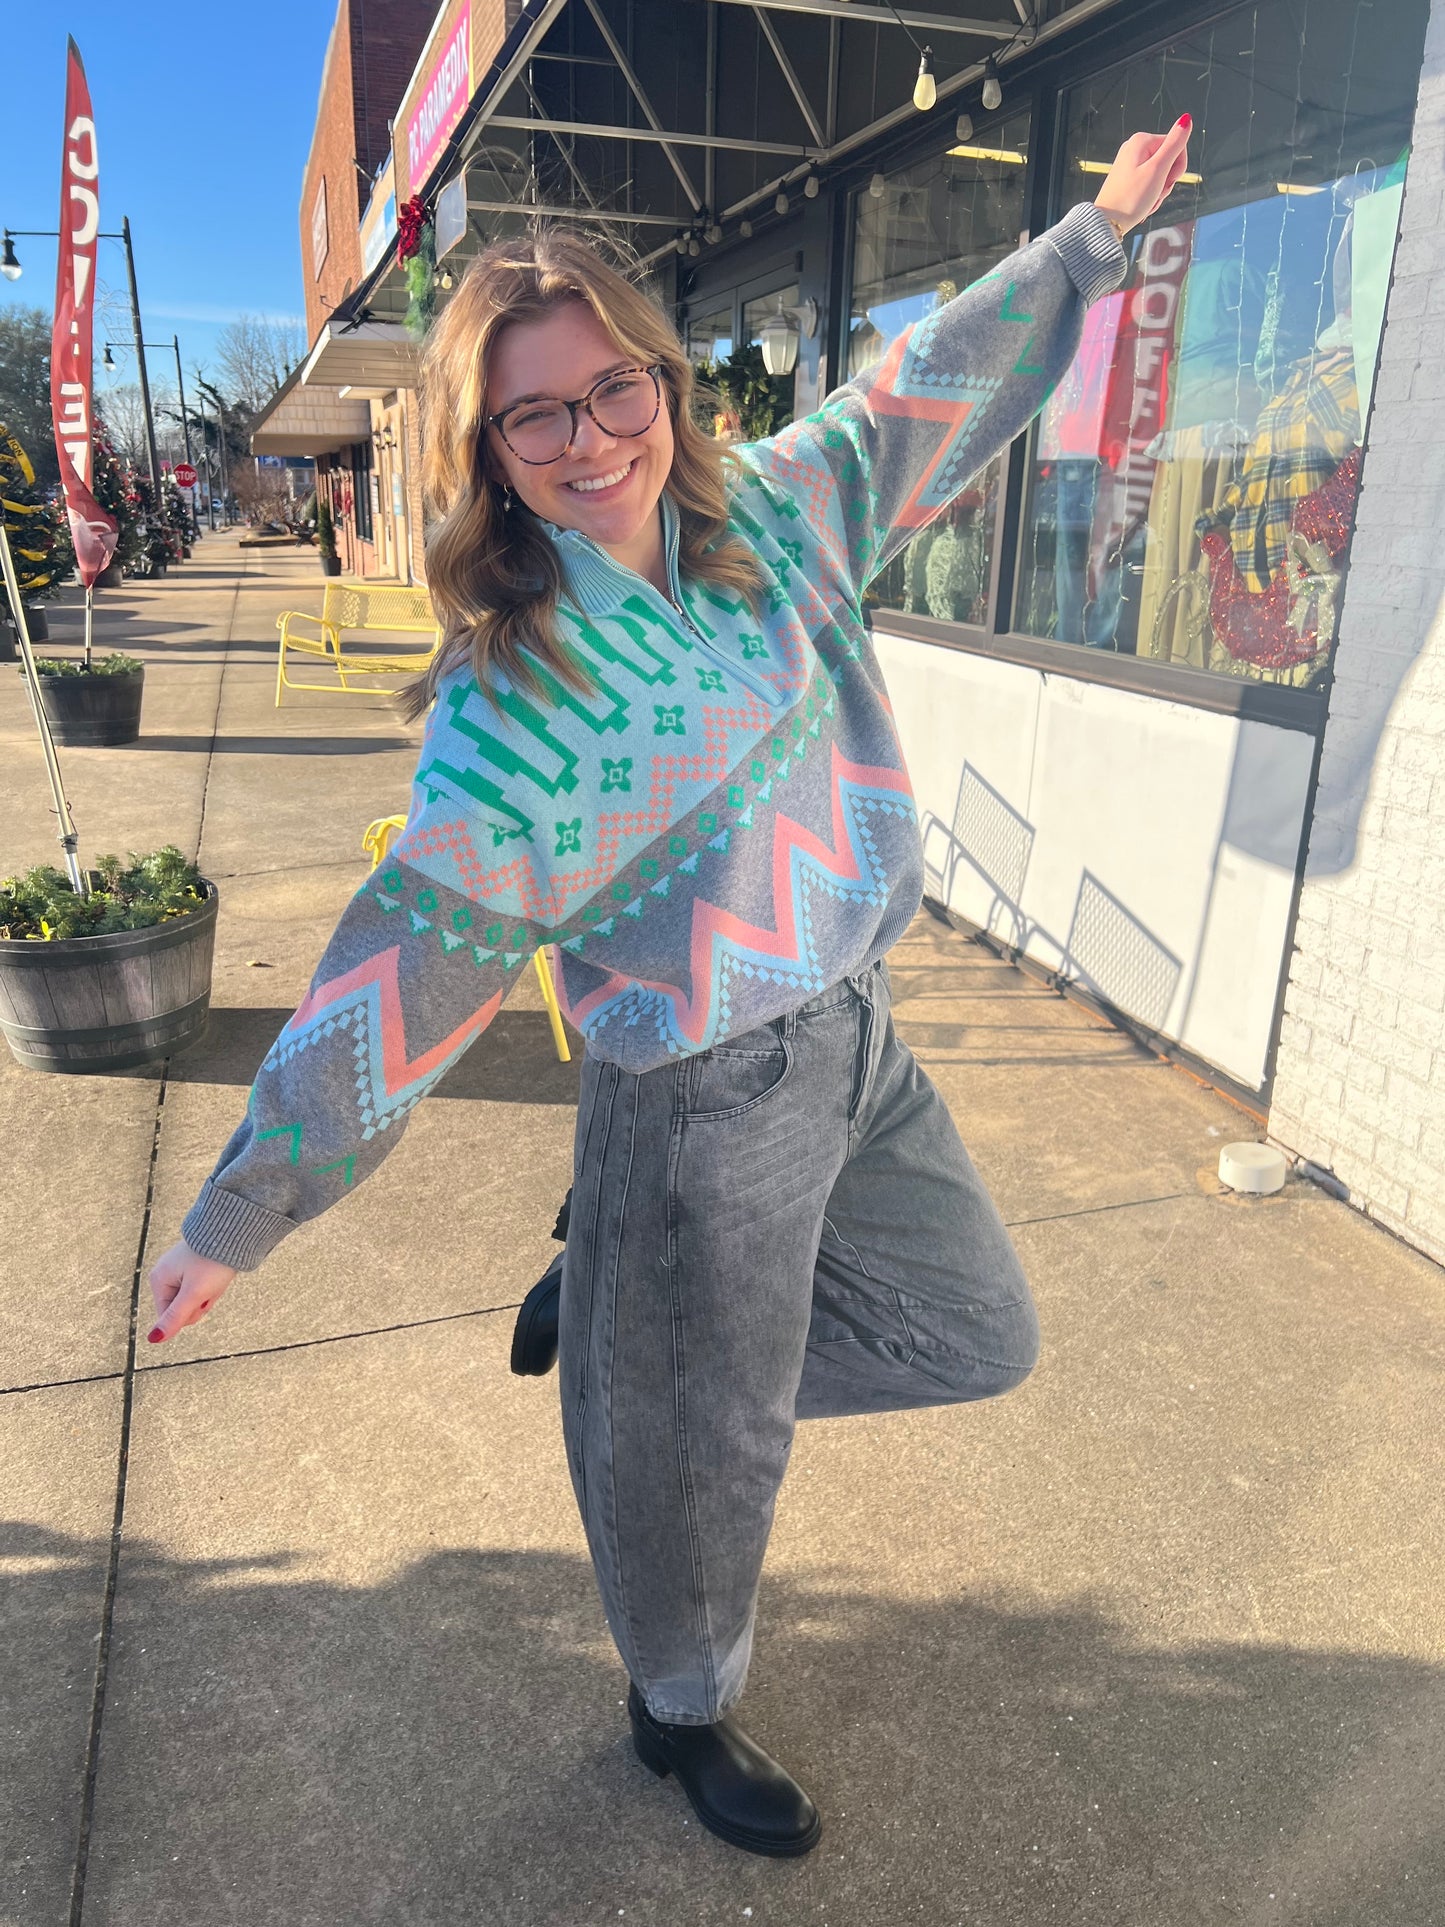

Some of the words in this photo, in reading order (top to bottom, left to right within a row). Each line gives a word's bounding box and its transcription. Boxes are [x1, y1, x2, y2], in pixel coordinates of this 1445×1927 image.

[409, 121, 420, 175] PC
[419, 16, 468, 156] PARAMEDIX
[175, 470, 196, 481] STOP
